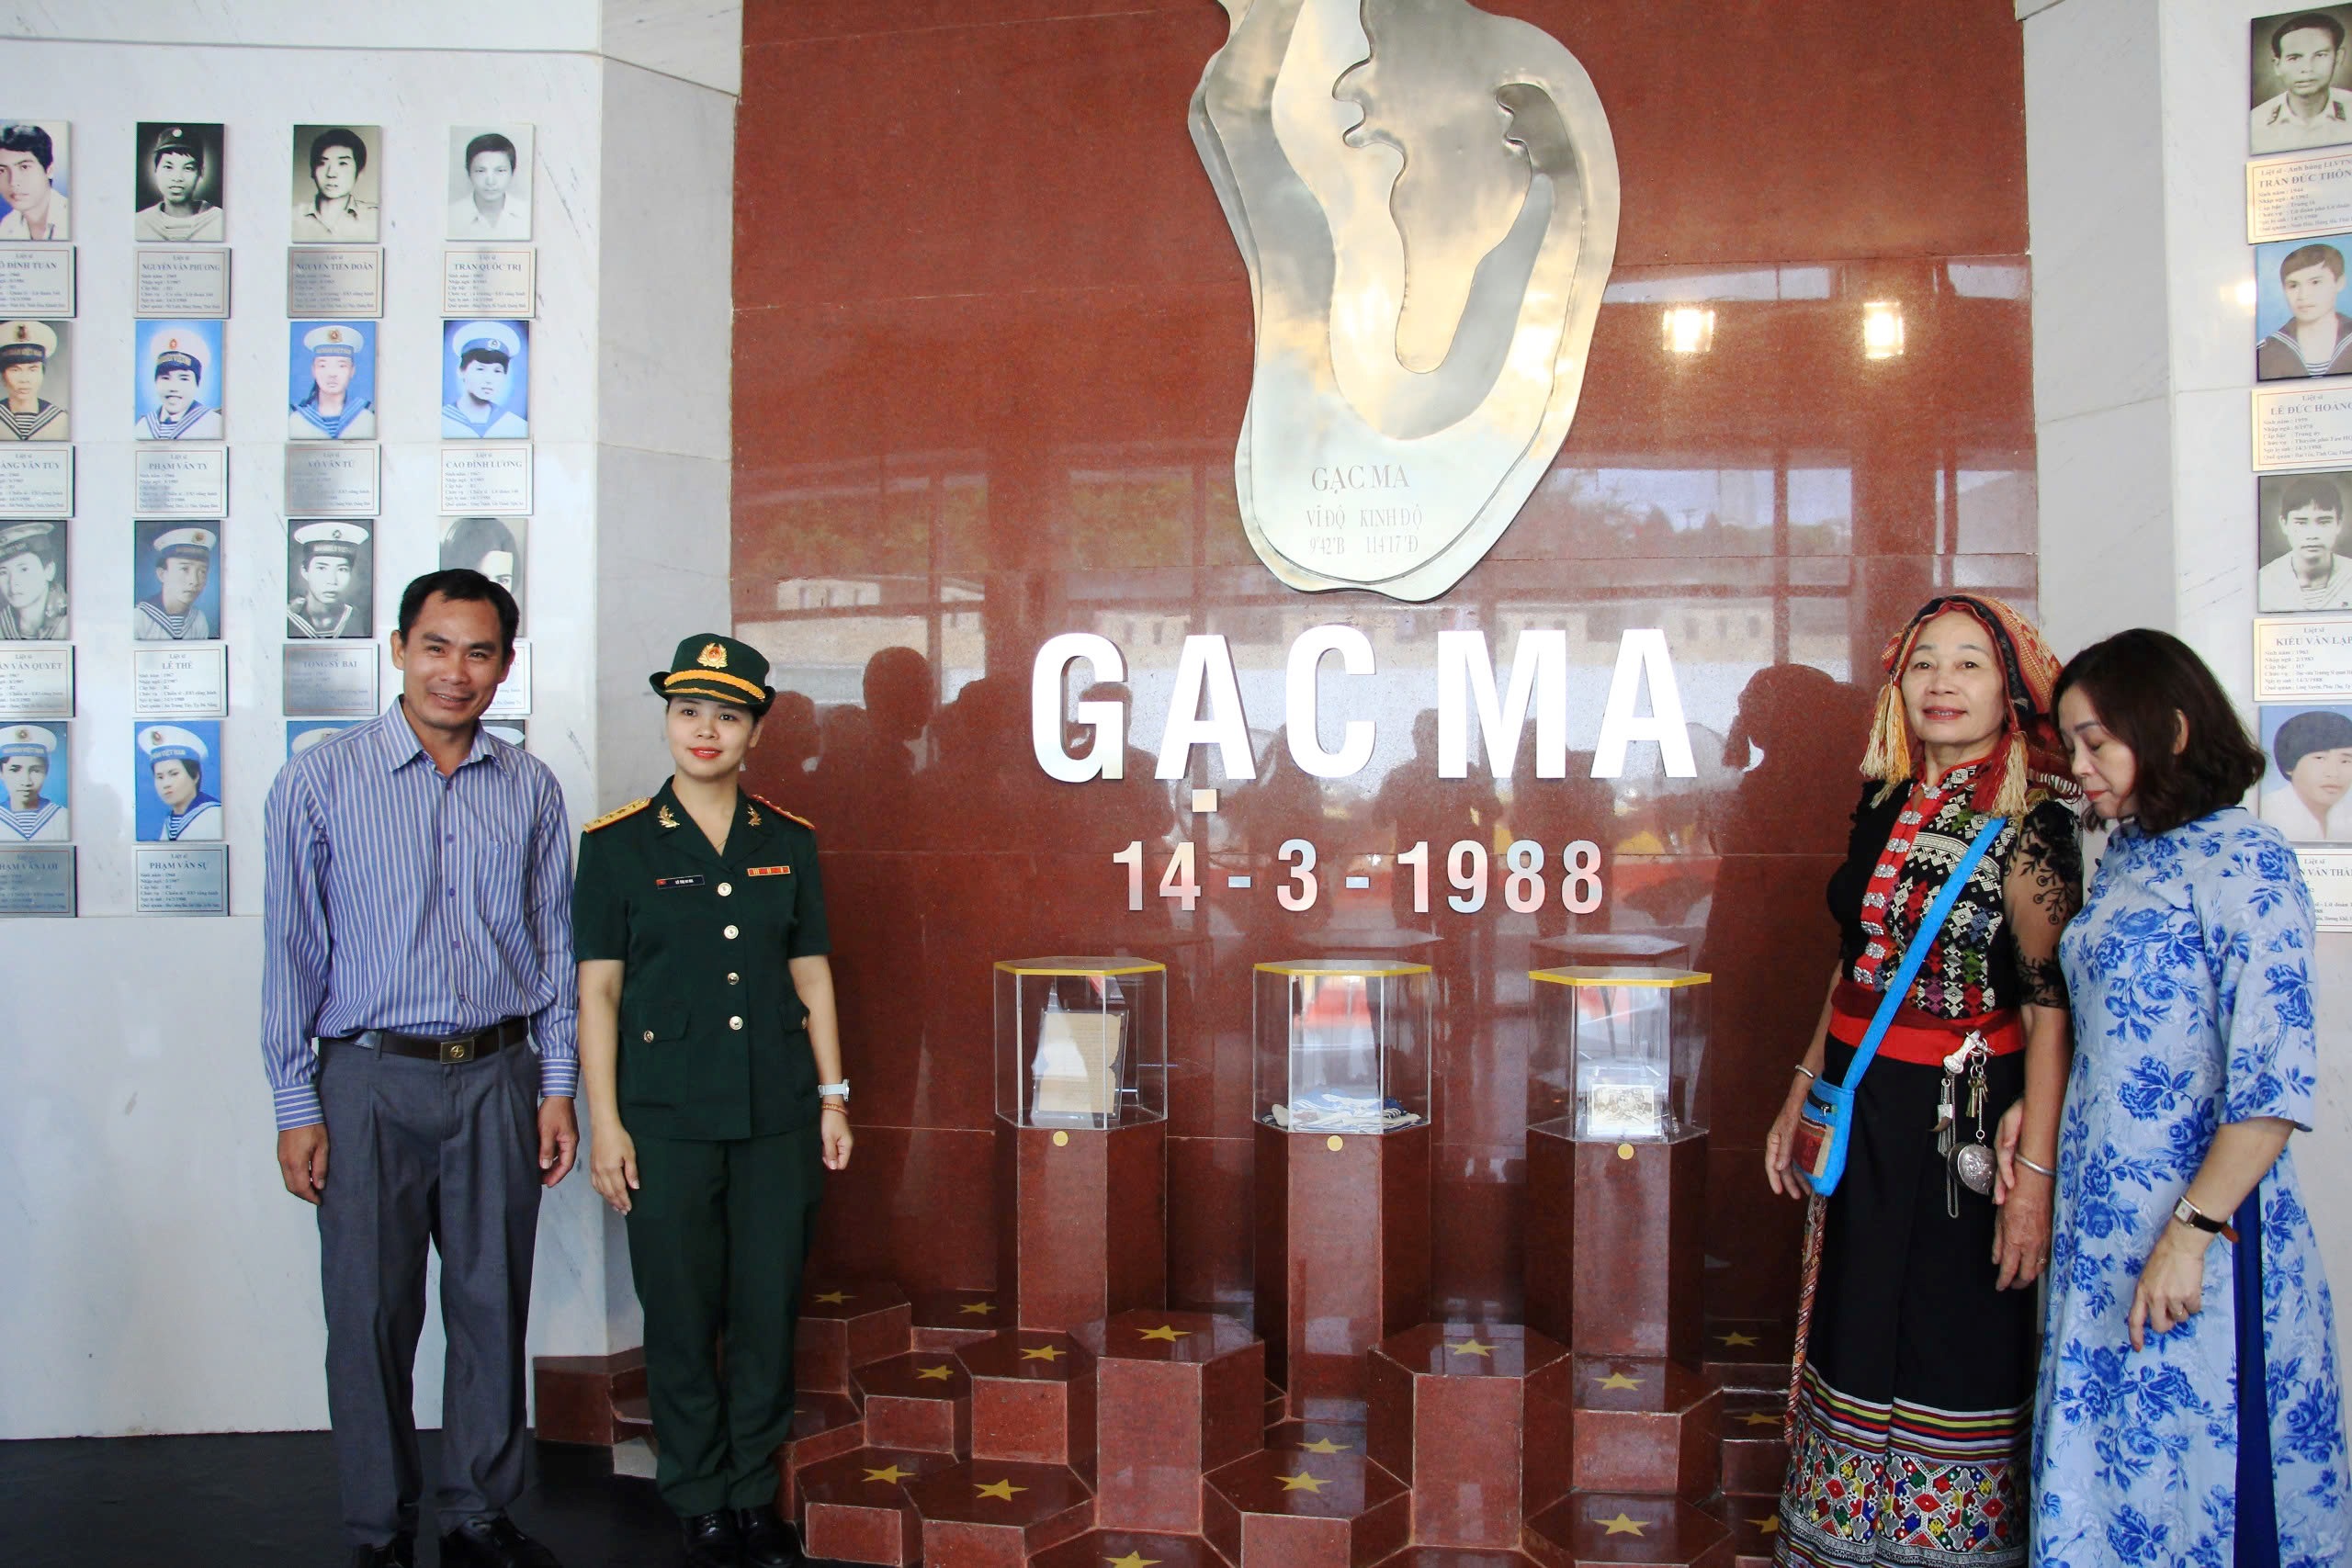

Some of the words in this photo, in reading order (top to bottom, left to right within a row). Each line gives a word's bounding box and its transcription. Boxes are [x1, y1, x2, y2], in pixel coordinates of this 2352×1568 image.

[2321, 169, 2352, 180] THÔN
[1371, 464, 1410, 489] MA
[1360, 509, 1396, 527] KINH
[1031, 625, 1377, 813] GẠC
[1437, 628, 1698, 780] MA
[1113, 840, 1202, 912] 14
[1277, 839, 1318, 912] 3
[1396, 839, 1603, 915] 1988
